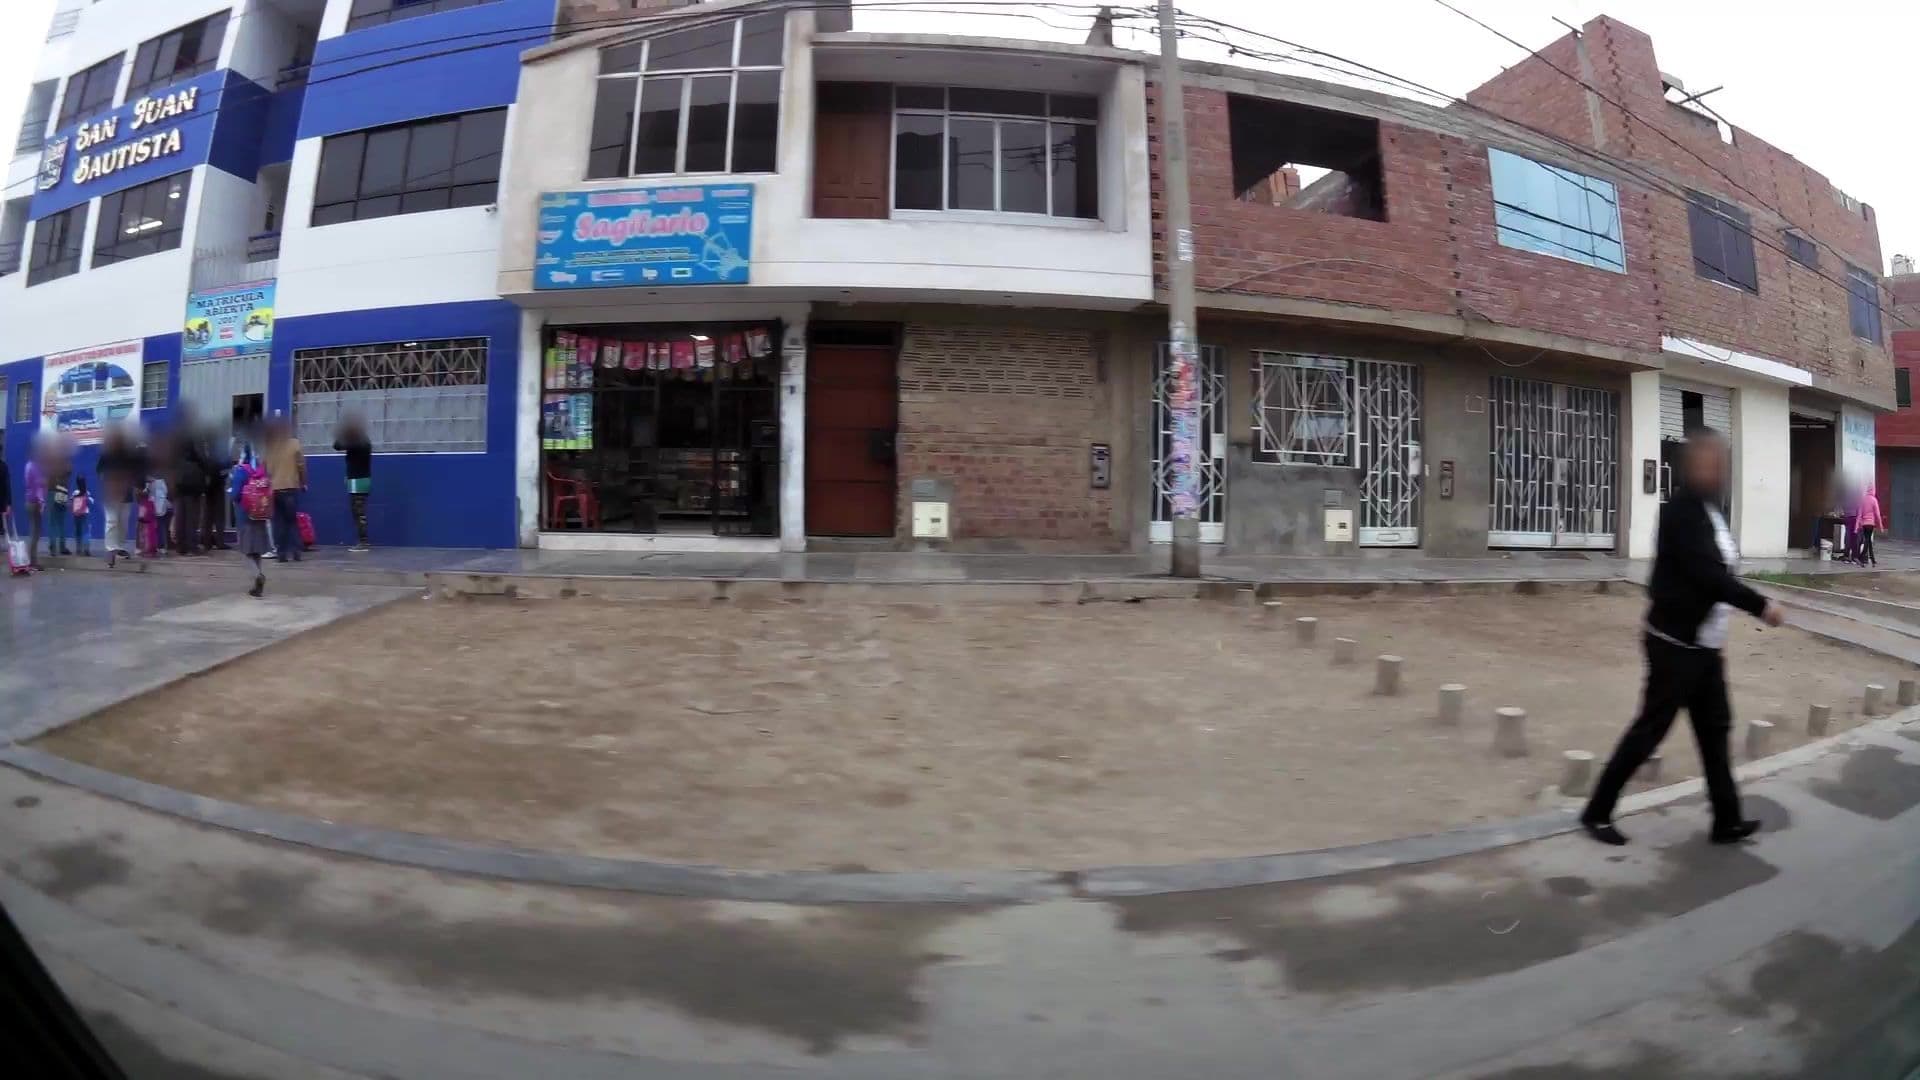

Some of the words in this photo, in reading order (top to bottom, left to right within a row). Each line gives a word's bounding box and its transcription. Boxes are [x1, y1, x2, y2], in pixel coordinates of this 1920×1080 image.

[75, 116, 116, 151] SAN
[130, 87, 198, 129] JUAN
[72, 128, 180, 184] BAUTISTA
[574, 207, 708, 245] Sagitario
[197, 291, 264, 308] MATRICULA
[205, 302, 254, 317] ABIERTA
